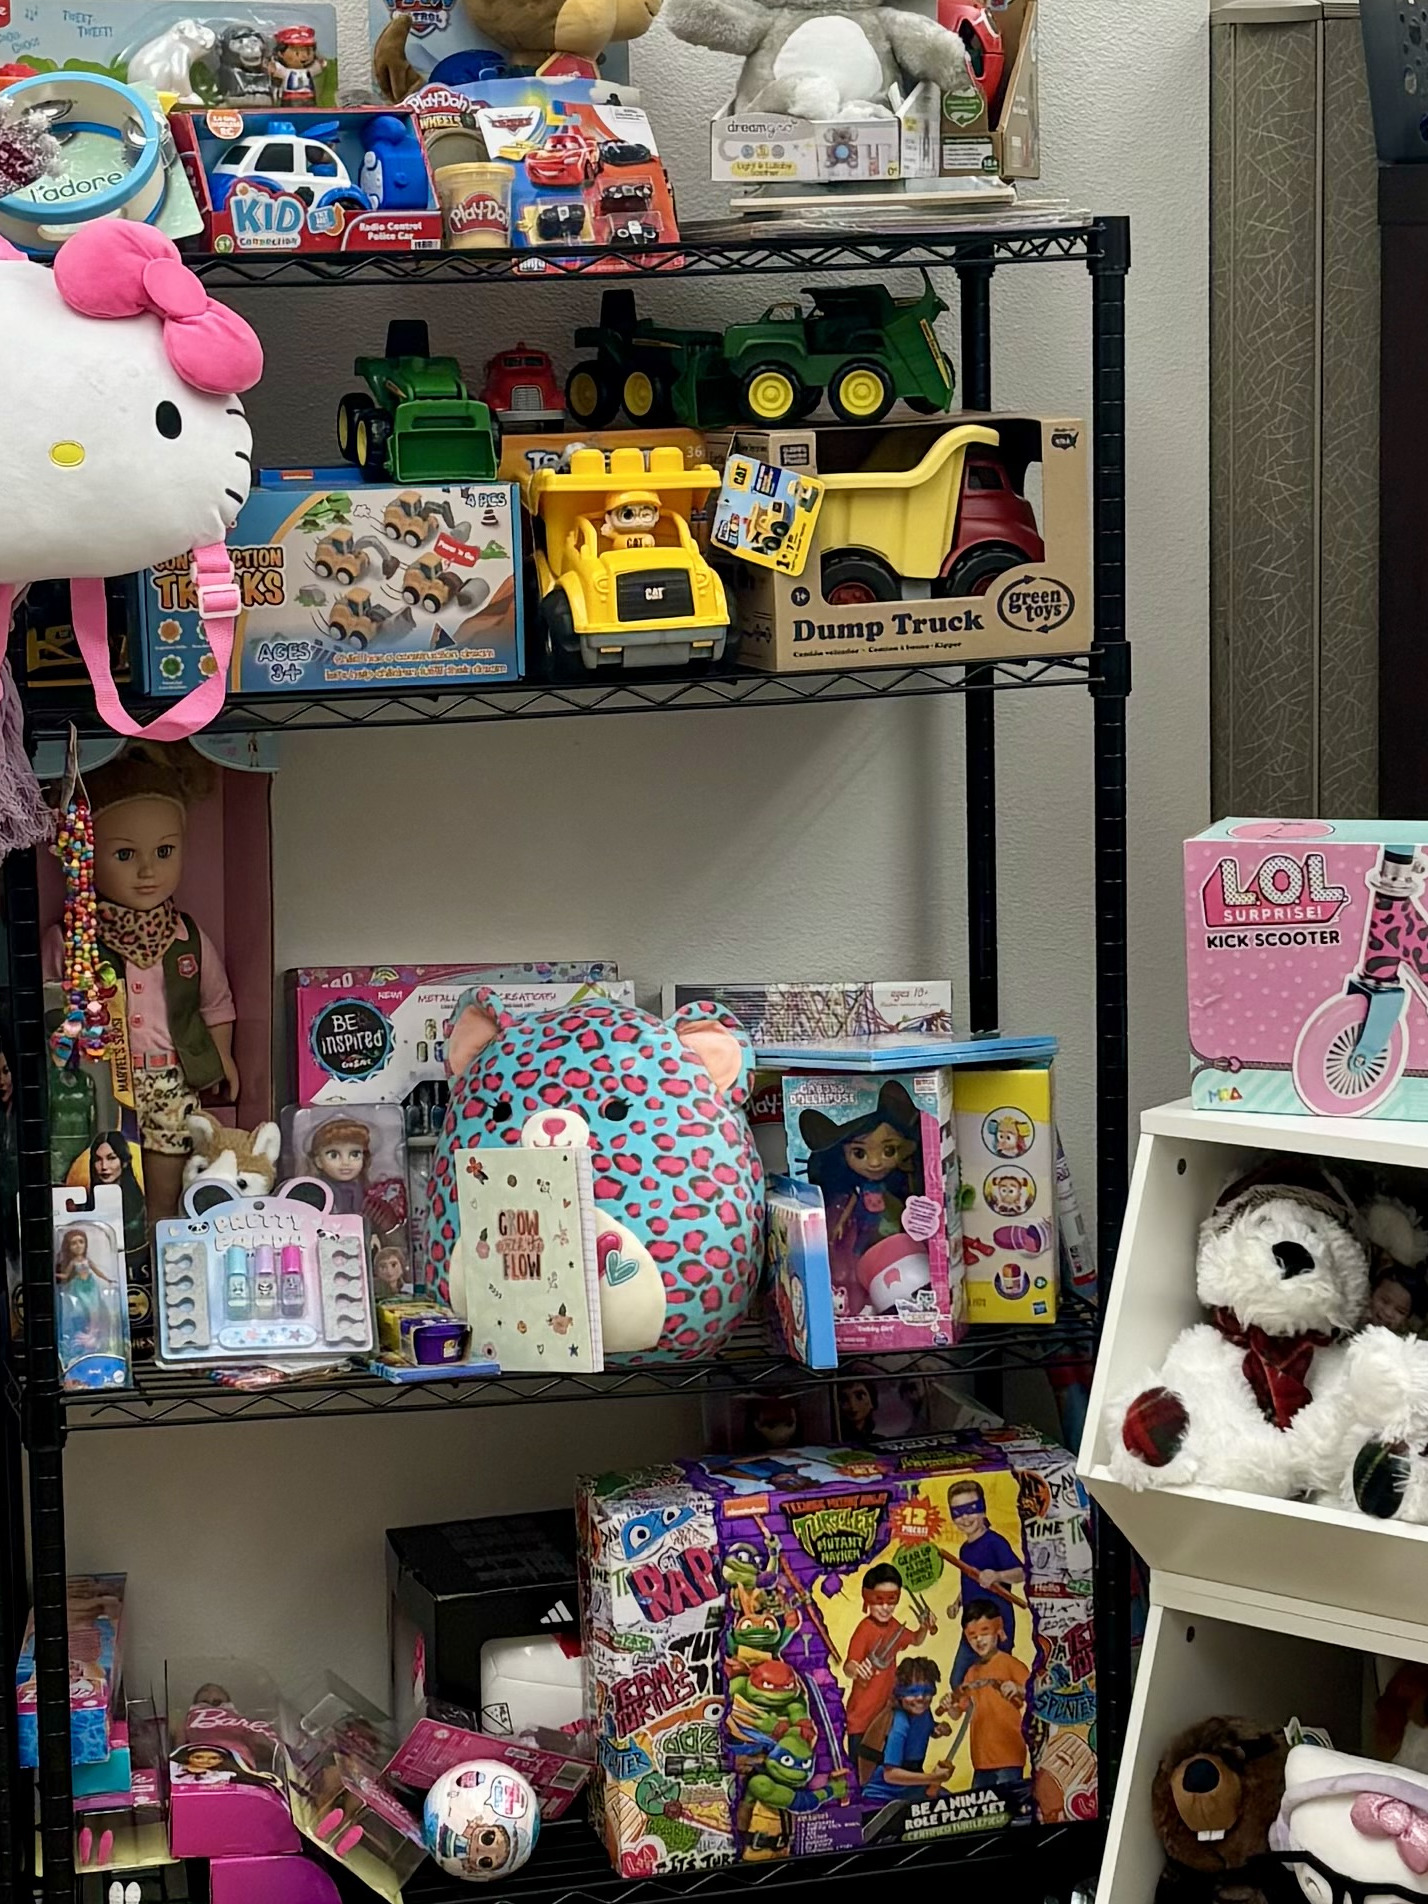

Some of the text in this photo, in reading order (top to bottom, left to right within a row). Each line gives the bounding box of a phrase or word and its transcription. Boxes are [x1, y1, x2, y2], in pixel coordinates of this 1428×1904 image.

[410, 90, 472, 115] Play-Doh
[29, 170, 105, 203] l'adore
[232, 198, 300, 234] KID
[359, 221, 422, 232] Radio Control
[368, 231, 414, 241] Police Car
[733, 464, 747, 487] CAT
[466, 492, 507, 506] 4 PCS
[627, 536, 644, 549] CAT
[643, 587, 664, 601] CAT
[1008, 588, 1062, 614] green
[1026, 602, 1062, 622] toys
[792, 609, 984, 645] Dump Truck
[259, 643, 312, 662] AGES
[273, 661, 303, 681] 3+
[1223, 904, 1323, 924] SURPRISE!
[1206, 929, 1341, 950] KICK SCOOTER
[332, 1013, 359, 1032] BE
[321, 1030, 385, 1056] inspired
[498, 1209, 541, 1237] GROW
[502, 1254, 541, 1281] FLOW
[901, 1506, 928, 1526] 12
[817, 1536, 864, 1553] MUTANT
[911, 1789, 1000, 1818] BE A NINJA
[905, 1800, 1007, 1831] ROLE PLAY SET
